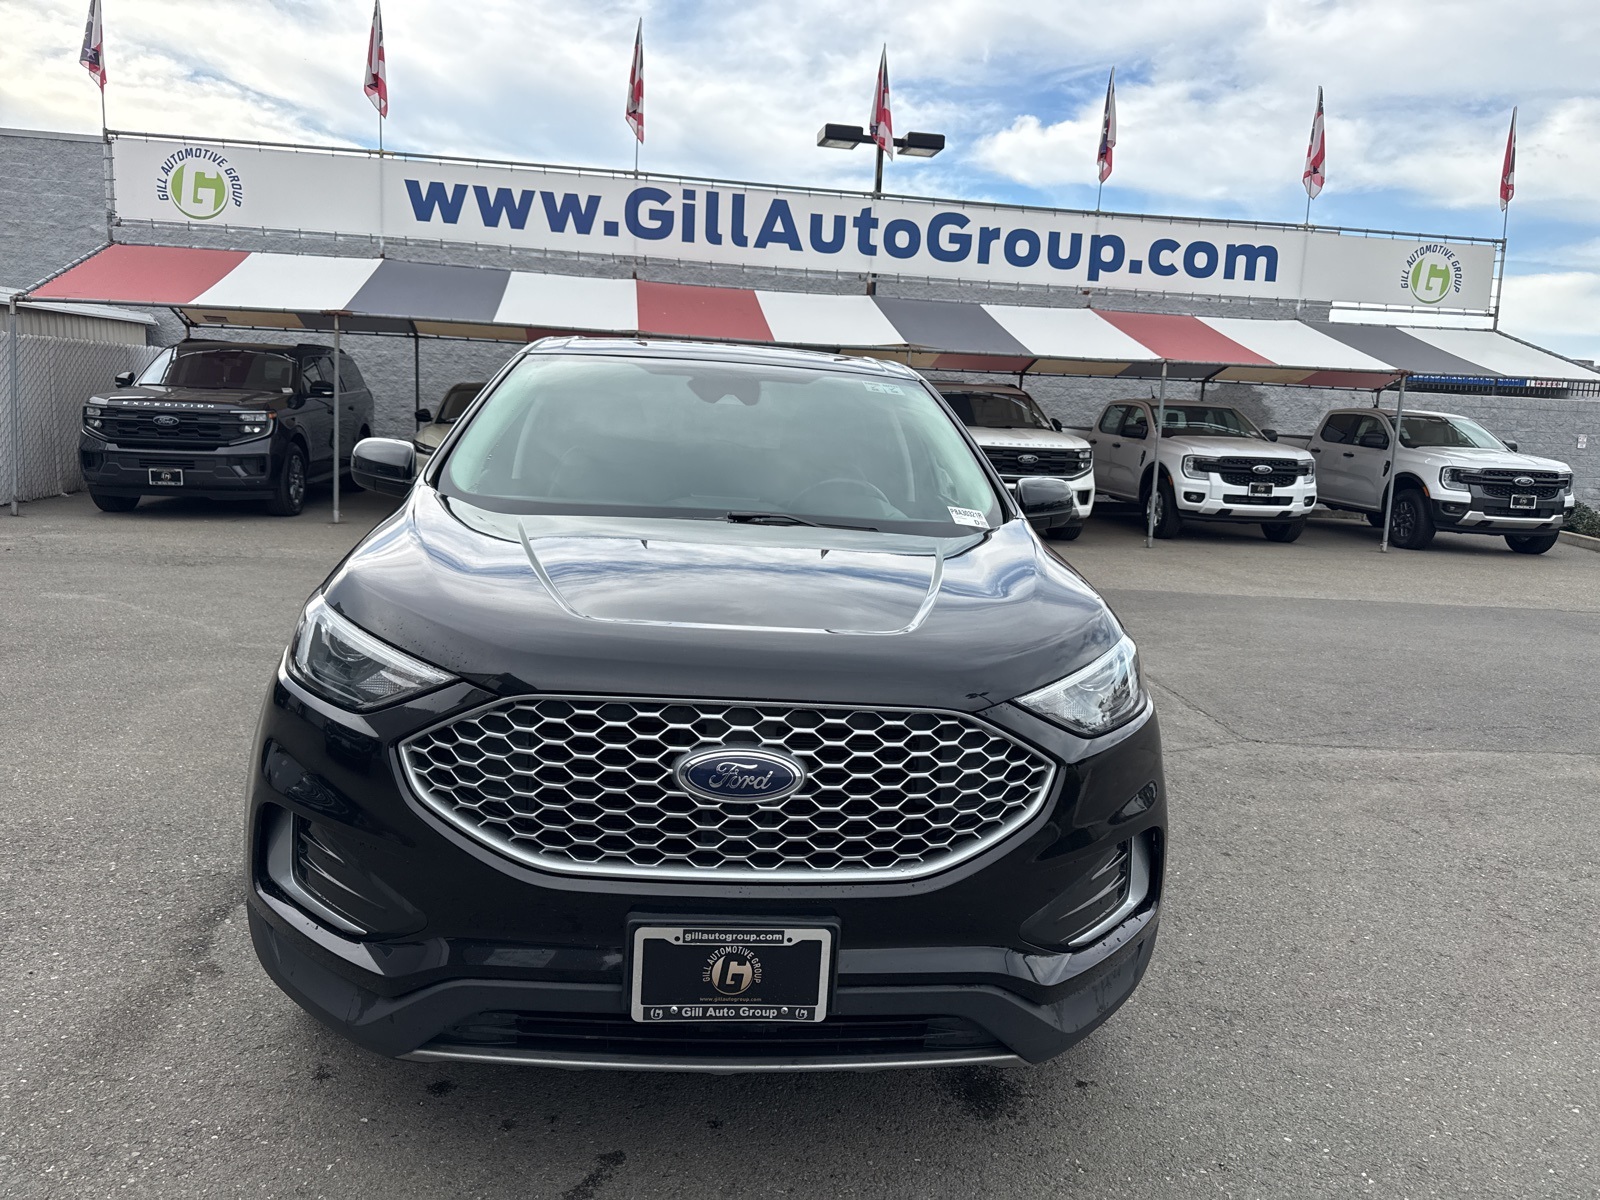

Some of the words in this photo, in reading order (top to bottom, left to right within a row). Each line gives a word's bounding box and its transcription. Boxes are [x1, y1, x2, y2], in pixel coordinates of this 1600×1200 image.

[161, 148, 228, 176] AUTOMOTIVE
[156, 178, 169, 201] GILL
[224, 167, 243, 207] GROUP
[404, 179, 1279, 282] www.GillAutoGroup.com
[1400, 269, 1410, 289] GILL
[1406, 244, 1456, 268] AUTOMOTIVE
[1451, 260, 1462, 293] GROUP
[708, 761, 774, 790] Ford
[684, 932, 783, 942] gillautogroup.com
[702, 966, 712, 982] GILL
[707, 945, 755, 966] AUTOMOTIVE
[751, 957, 763, 984] GROUP
[681, 1007, 703, 1018] Gill
[706, 1007, 736, 1018] Auto
[739, 1007, 778, 1019] Group
